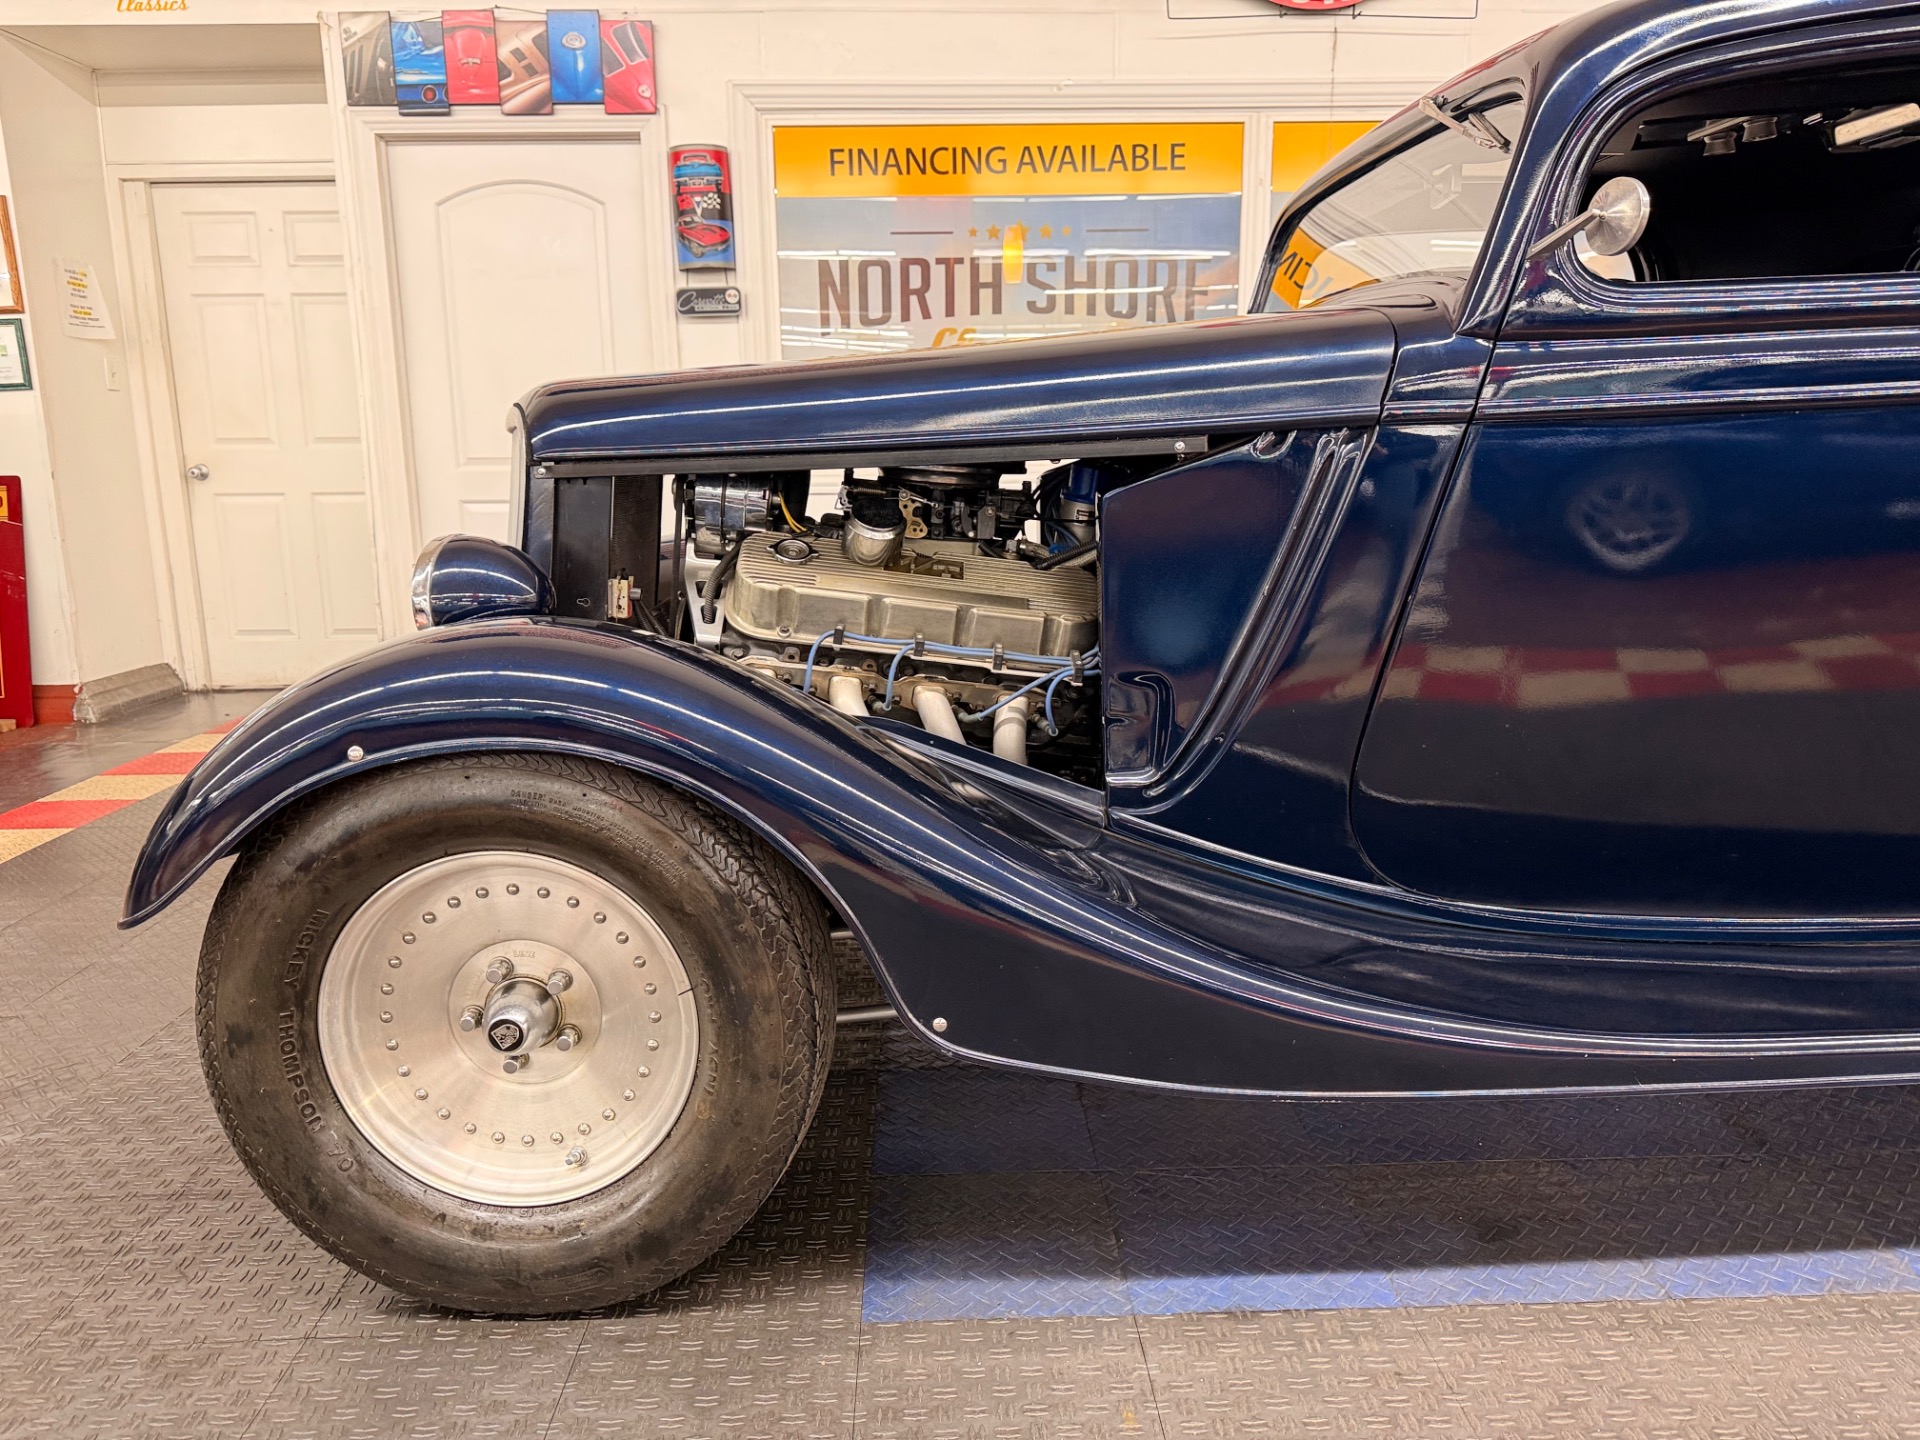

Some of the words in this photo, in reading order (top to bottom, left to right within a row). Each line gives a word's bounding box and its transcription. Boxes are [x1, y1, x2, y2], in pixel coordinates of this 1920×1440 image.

[829, 146, 1007, 176] FINANCING
[1016, 143, 1186, 173] AVAILABLE
[818, 257, 1002, 336] NORTH
[284, 908, 330, 990] MICKEY
[278, 1007, 325, 1134] THOMPSON
